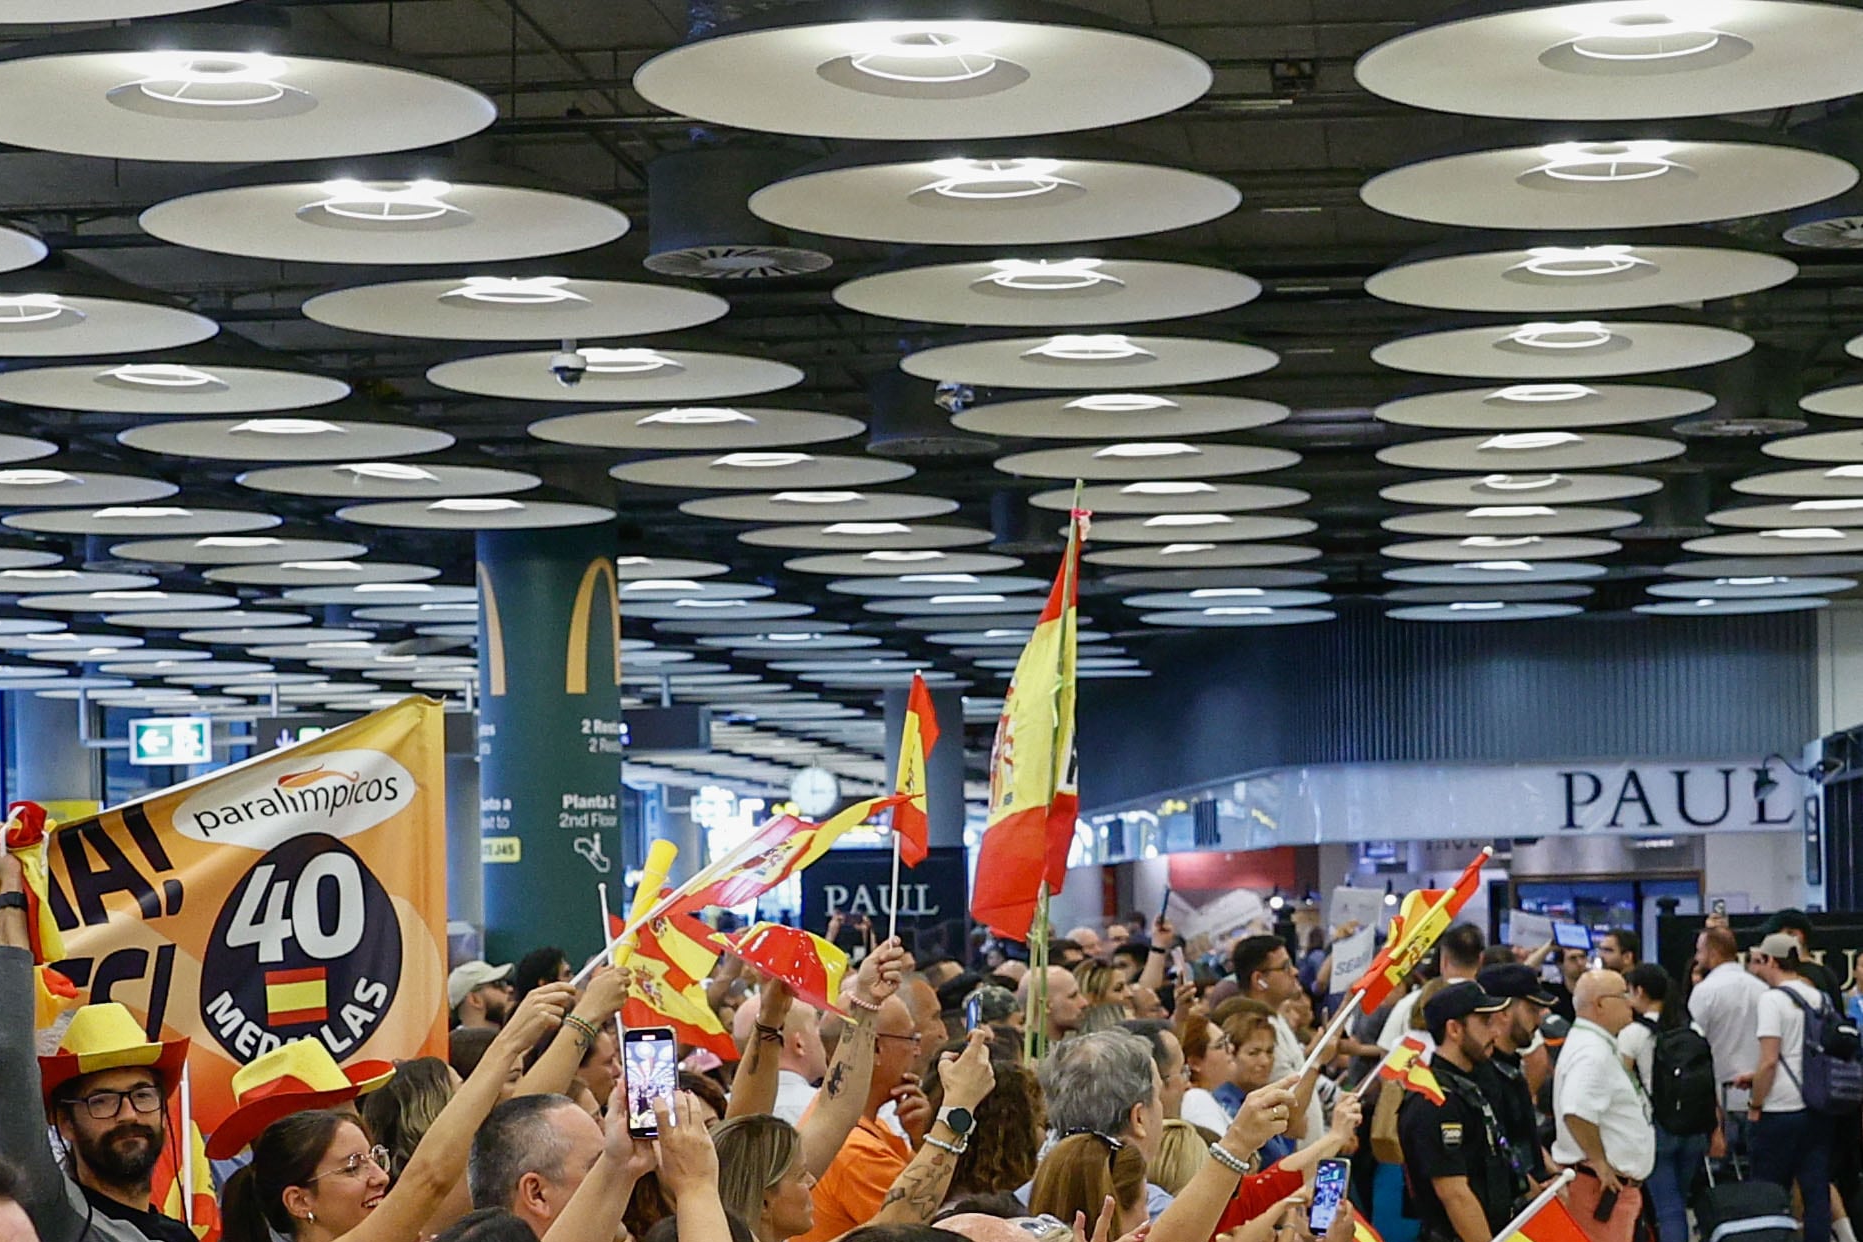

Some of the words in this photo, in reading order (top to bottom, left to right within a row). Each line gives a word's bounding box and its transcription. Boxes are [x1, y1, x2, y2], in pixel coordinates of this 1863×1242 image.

[558, 812, 589, 828] 2nd
[562, 794, 606, 809] Planta
[1557, 768, 1797, 830] PAUL
[225, 851, 365, 964] 40
[822, 884, 940, 917] PAUL
[205, 976, 388, 1058] MEDLAS
